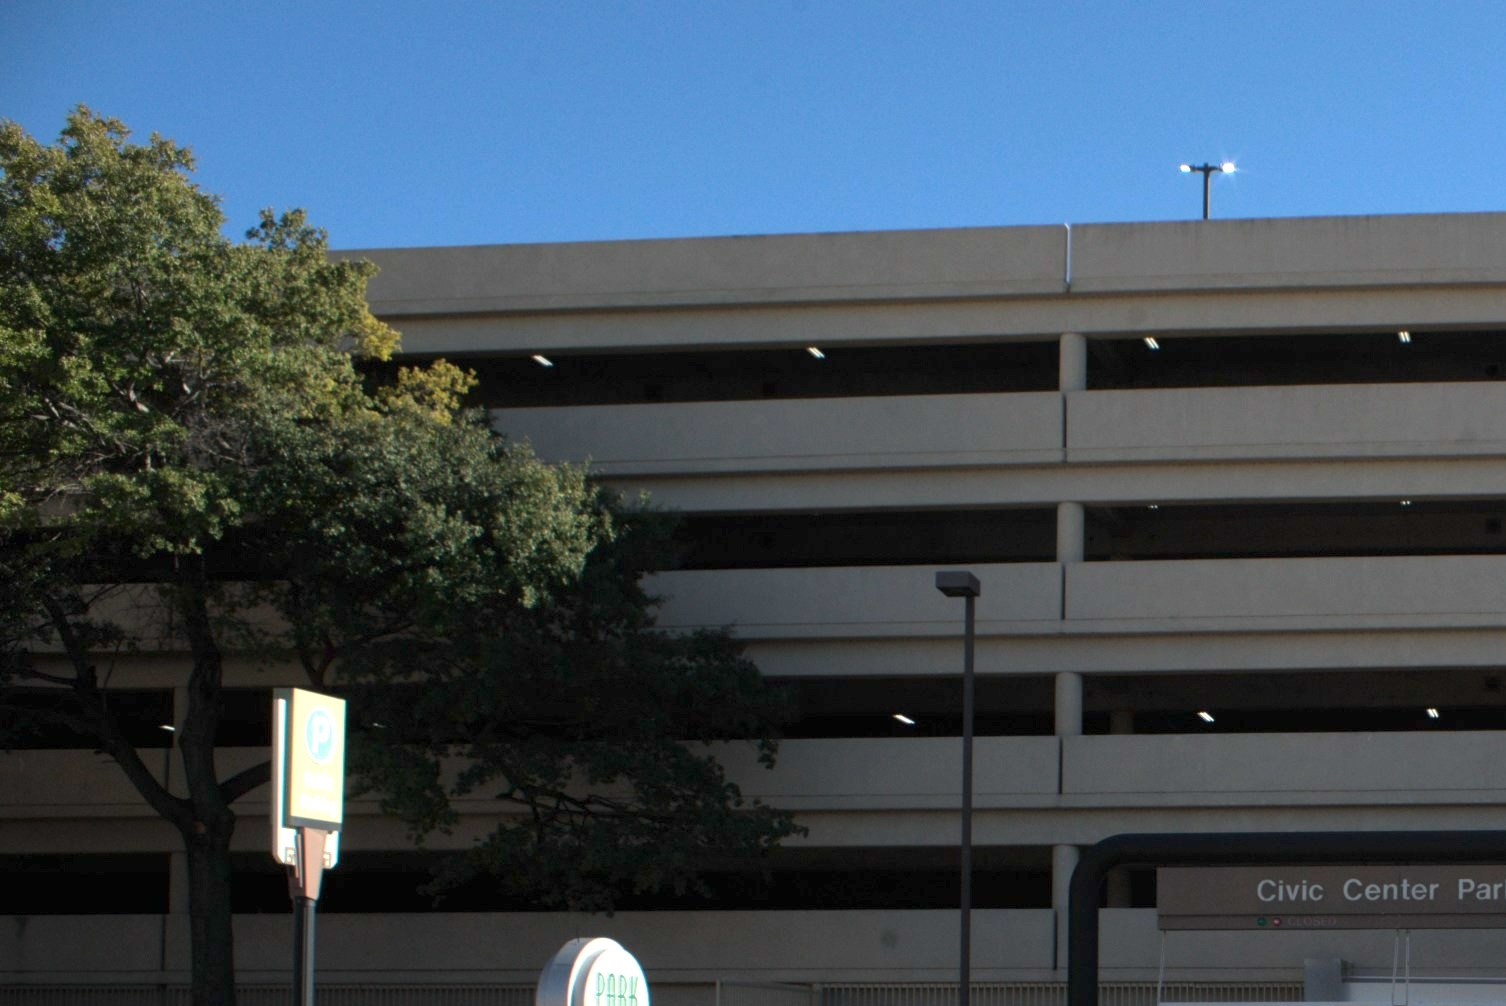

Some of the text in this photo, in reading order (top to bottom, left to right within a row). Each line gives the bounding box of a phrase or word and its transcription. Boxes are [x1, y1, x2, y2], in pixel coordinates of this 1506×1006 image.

[312, 714, 331, 754] P
[1257, 880, 1324, 902] Civic
[1343, 879, 1439, 901] Center
[1287, 915, 1337, 927] CLOSED
